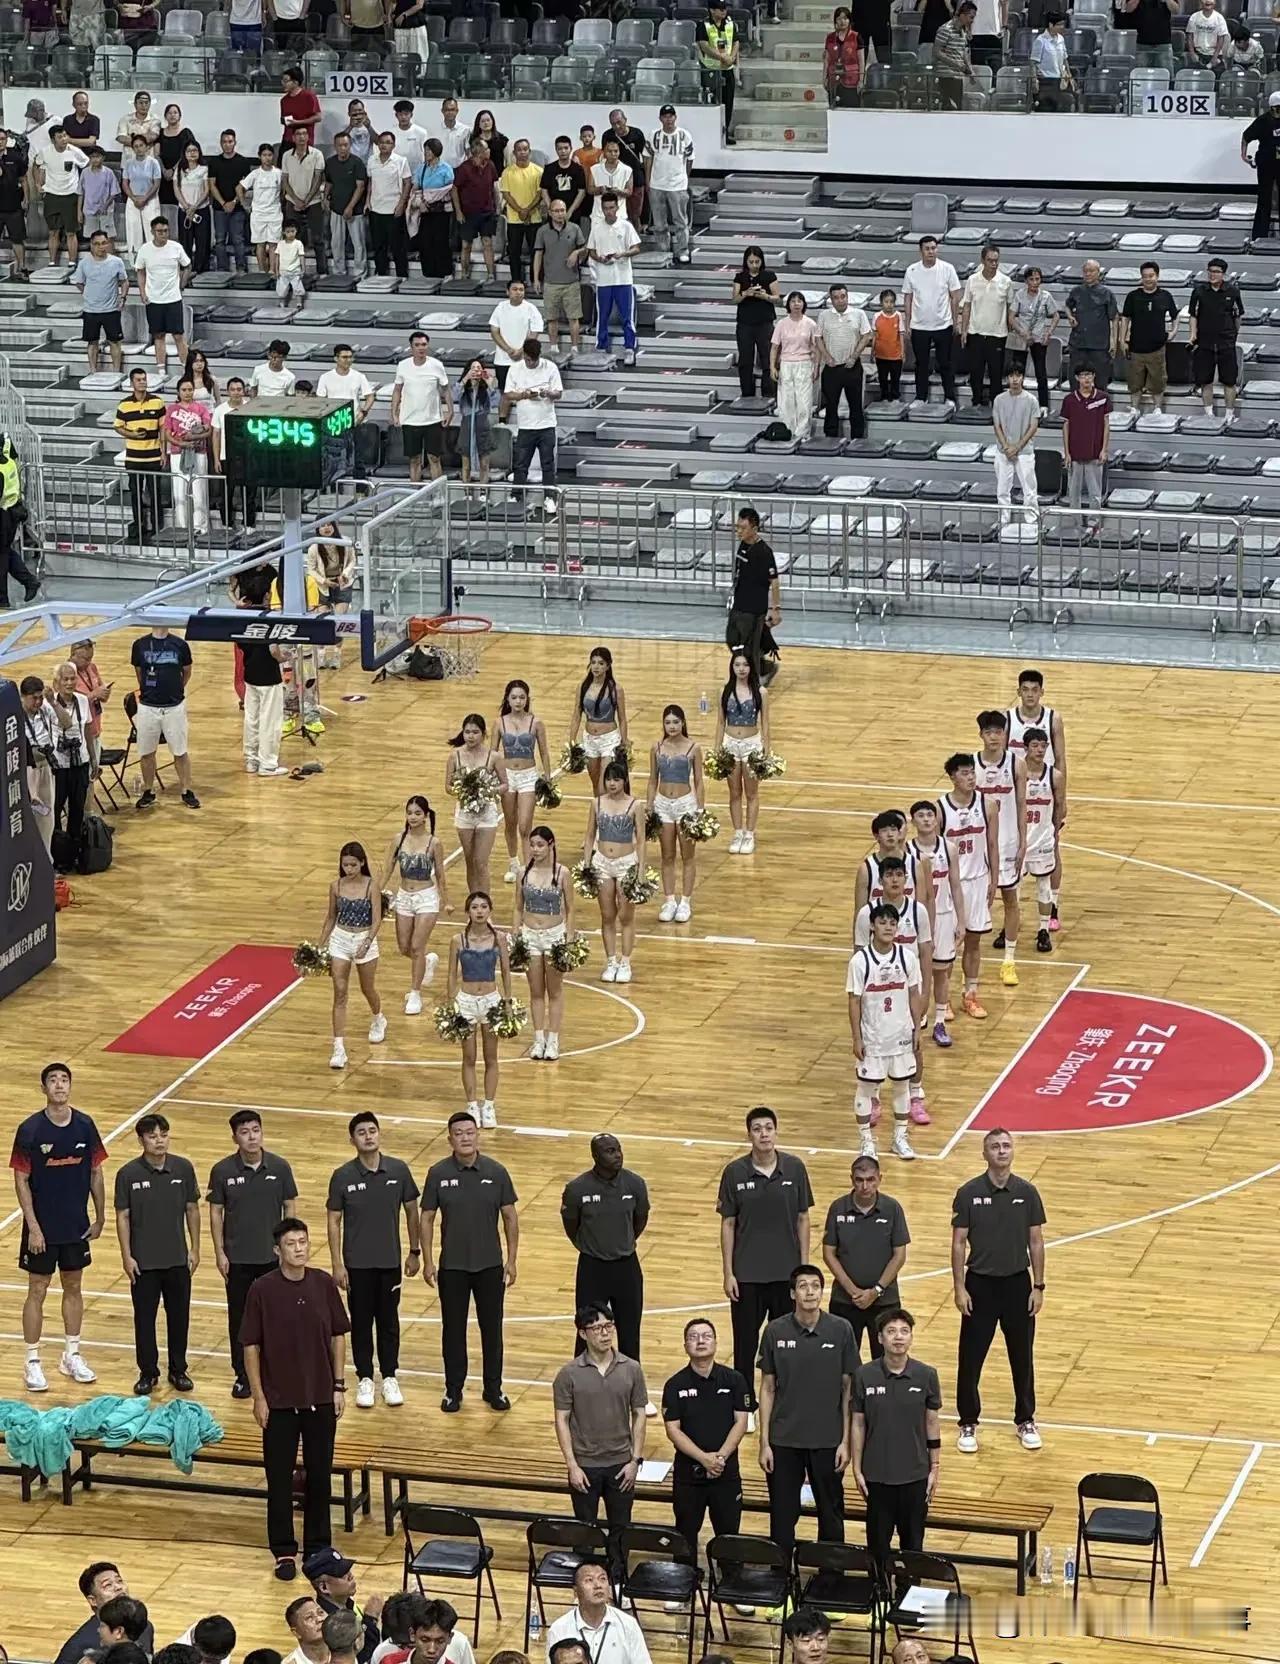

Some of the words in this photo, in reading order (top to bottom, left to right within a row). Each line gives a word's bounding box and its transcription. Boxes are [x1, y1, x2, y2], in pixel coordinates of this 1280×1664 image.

[330, 75, 389, 95] 109区
[1147, 95, 1210, 115] 108区
[243, 623, 299, 640] 金陵
[5, 714, 24, 839] 金陵体育
[173, 977, 240, 1020] ZEEKR
[883, 996, 893, 1013] 2
[1086, 1023, 1178, 1108] ZEEKR
